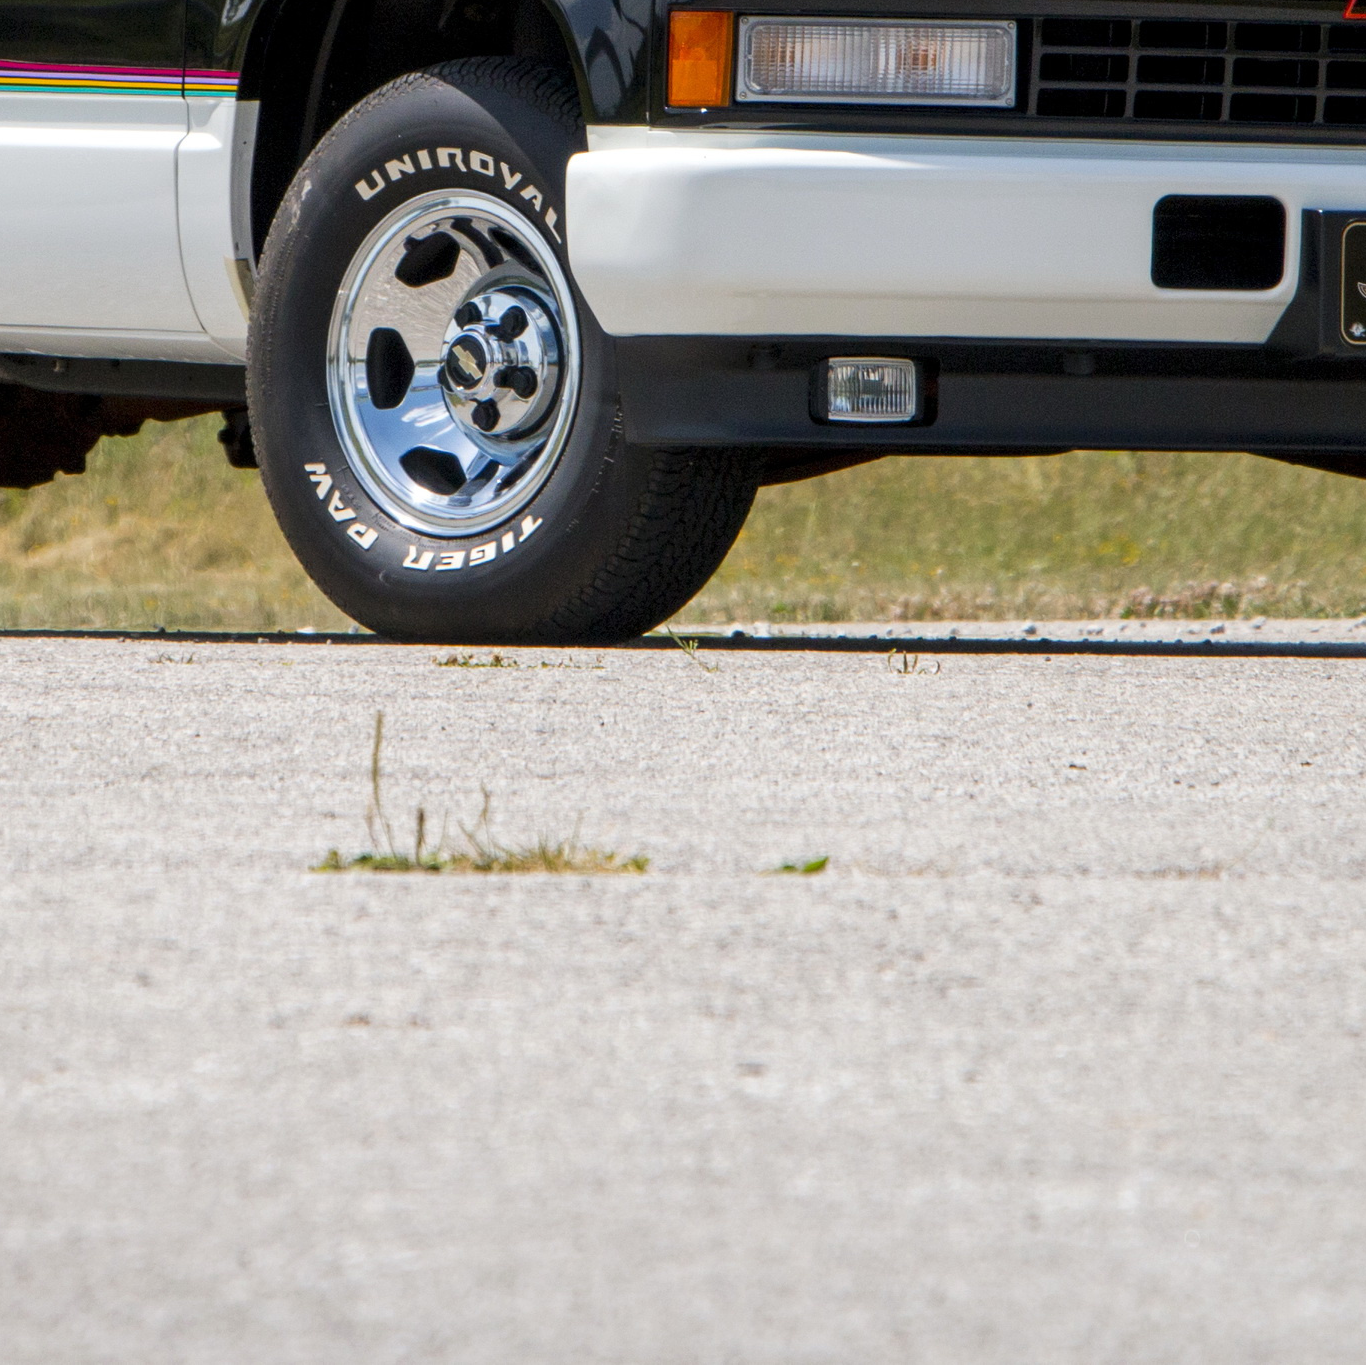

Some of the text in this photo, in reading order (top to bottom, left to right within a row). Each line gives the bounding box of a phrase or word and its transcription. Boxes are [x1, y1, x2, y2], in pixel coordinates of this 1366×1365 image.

[354, 146, 562, 245] UNIROYAL
[304, 462, 379, 550] PAW
[402, 515, 544, 571] TIGER
